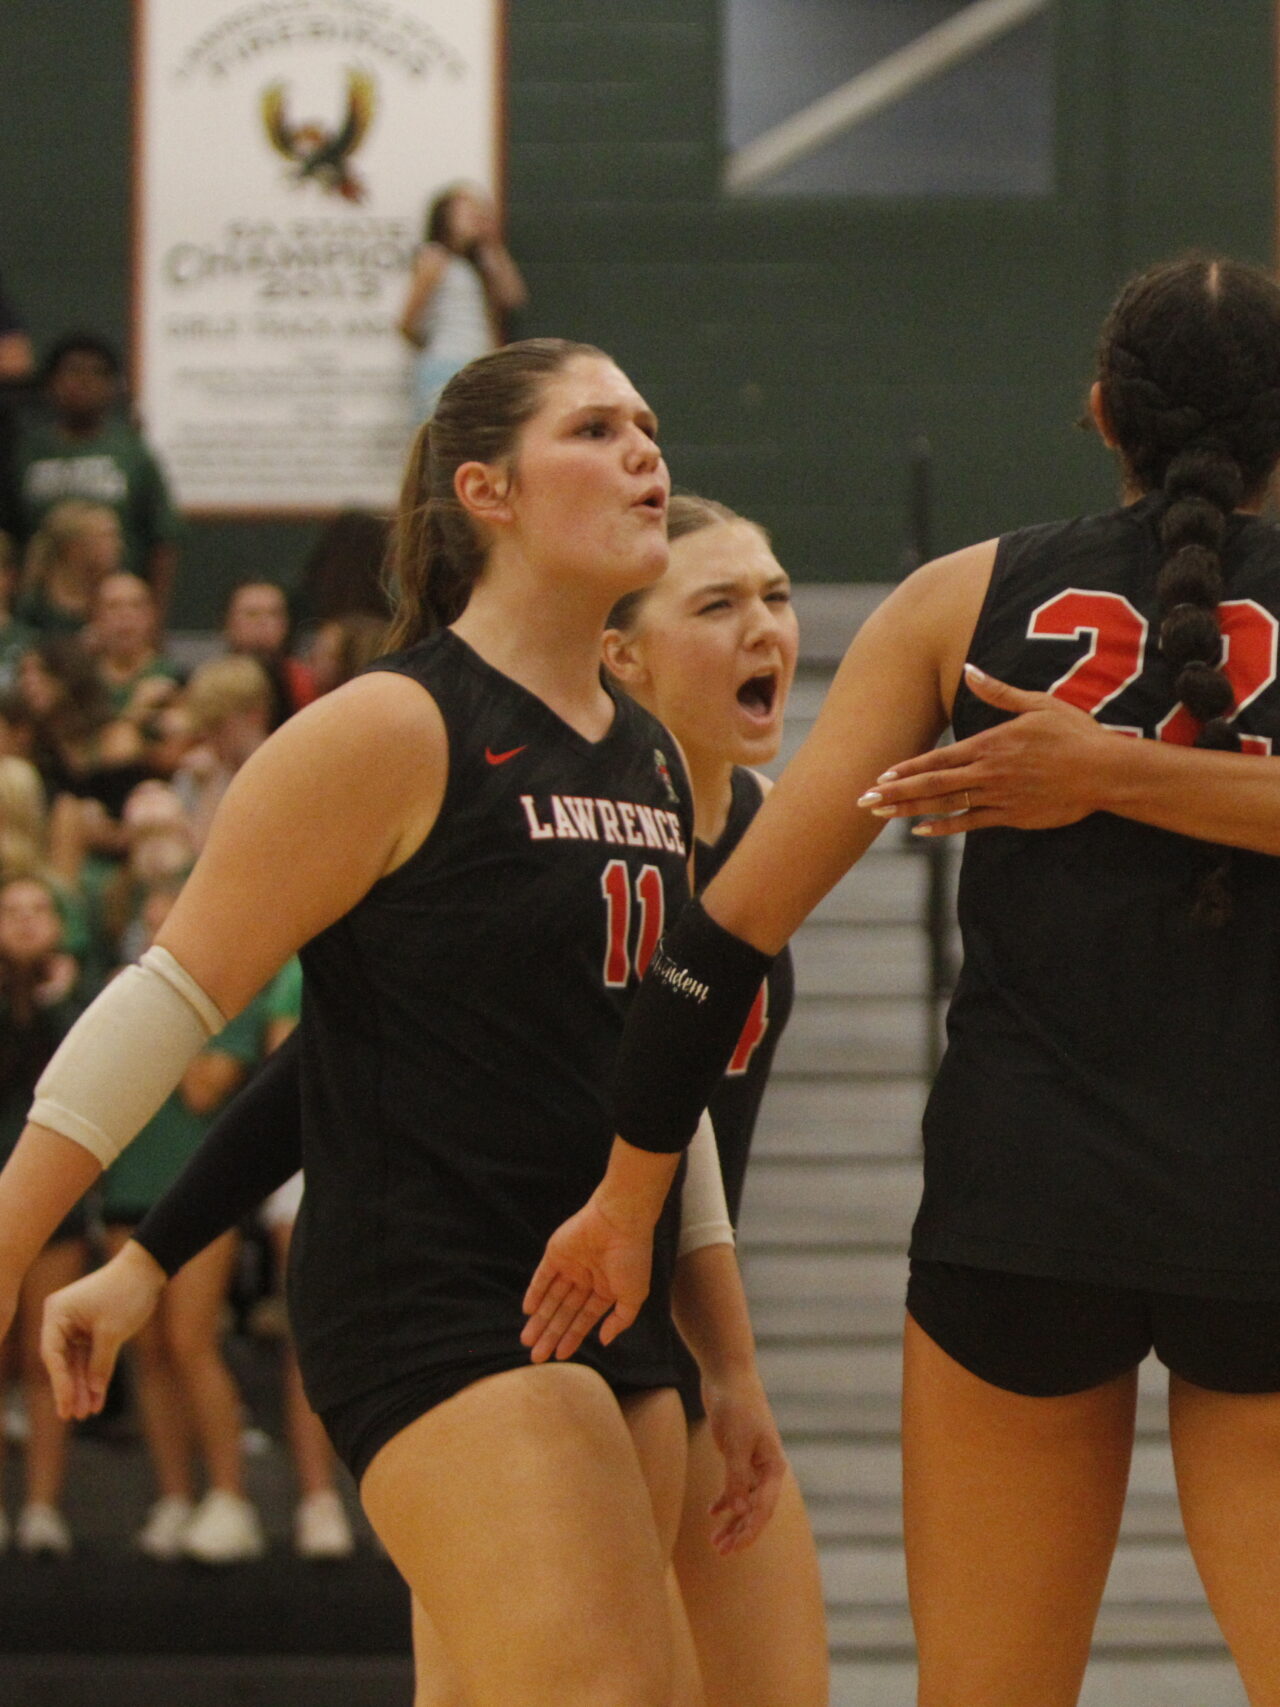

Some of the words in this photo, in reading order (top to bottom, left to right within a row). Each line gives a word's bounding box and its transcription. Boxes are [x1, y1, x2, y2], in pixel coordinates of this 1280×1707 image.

[1026, 587, 1280, 757] 22
[519, 794, 686, 856] LAWRENCE
[600, 859, 665, 988] 11
